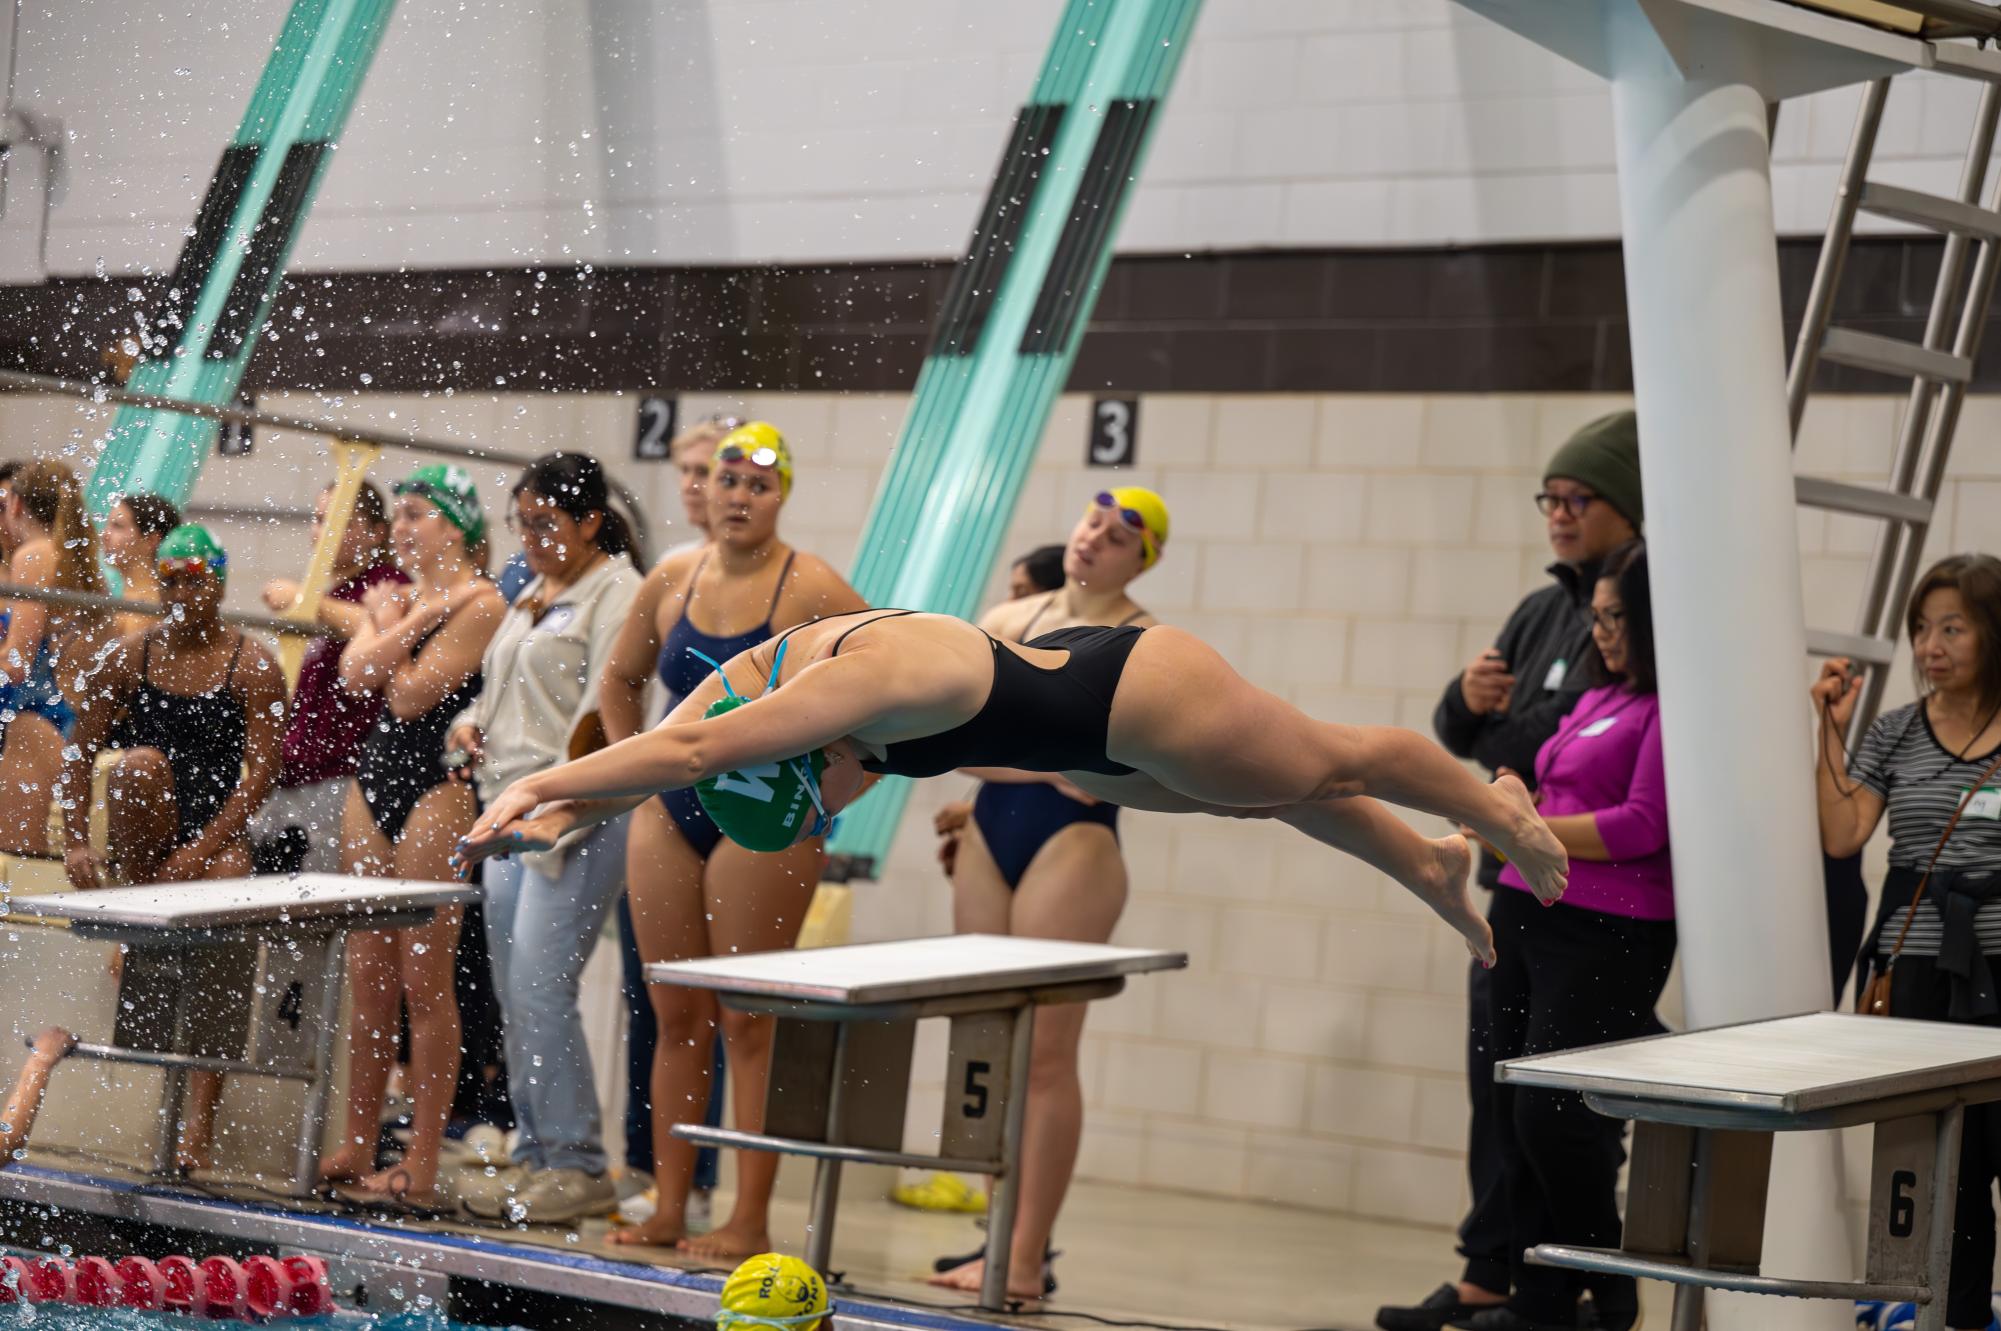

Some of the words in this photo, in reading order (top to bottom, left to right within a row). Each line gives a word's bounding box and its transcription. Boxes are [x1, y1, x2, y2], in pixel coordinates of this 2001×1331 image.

[640, 399, 671, 455] 2
[1093, 400, 1130, 463] 3
[278, 981, 303, 1029] 4
[962, 1061, 990, 1119] 5
[1889, 1170, 1916, 1237] 6
